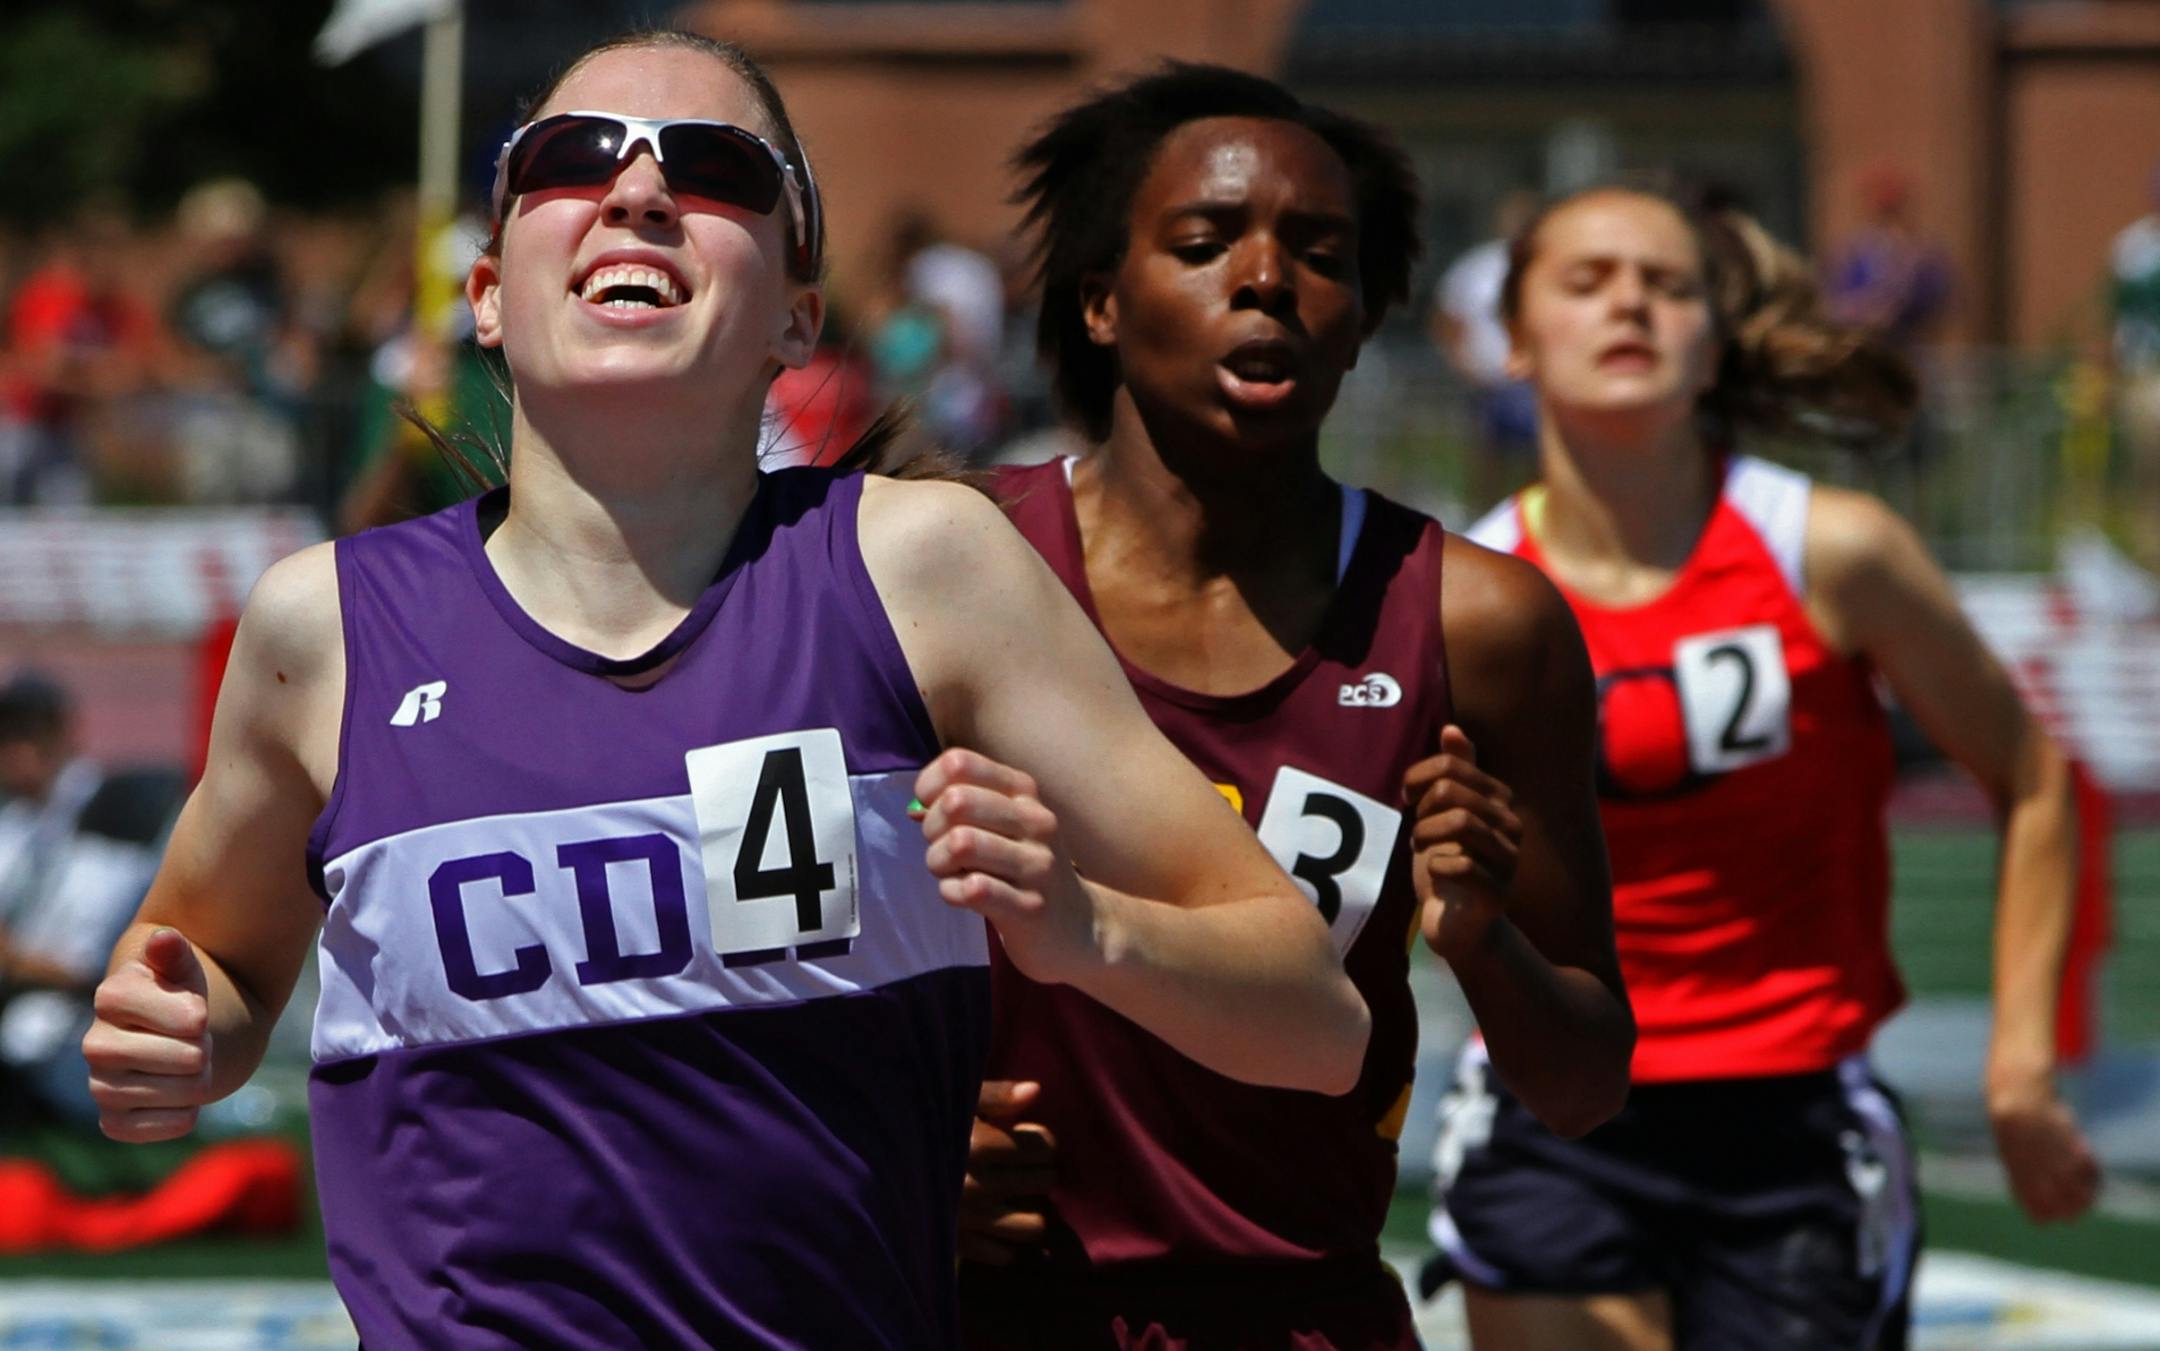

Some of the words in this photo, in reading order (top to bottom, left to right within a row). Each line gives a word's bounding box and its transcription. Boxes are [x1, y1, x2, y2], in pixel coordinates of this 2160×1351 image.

[1705, 644, 1775, 753] 2
[733, 746, 836, 933] 4
[1291, 791, 1365, 929] 3
[428, 832, 850, 1002] CD
